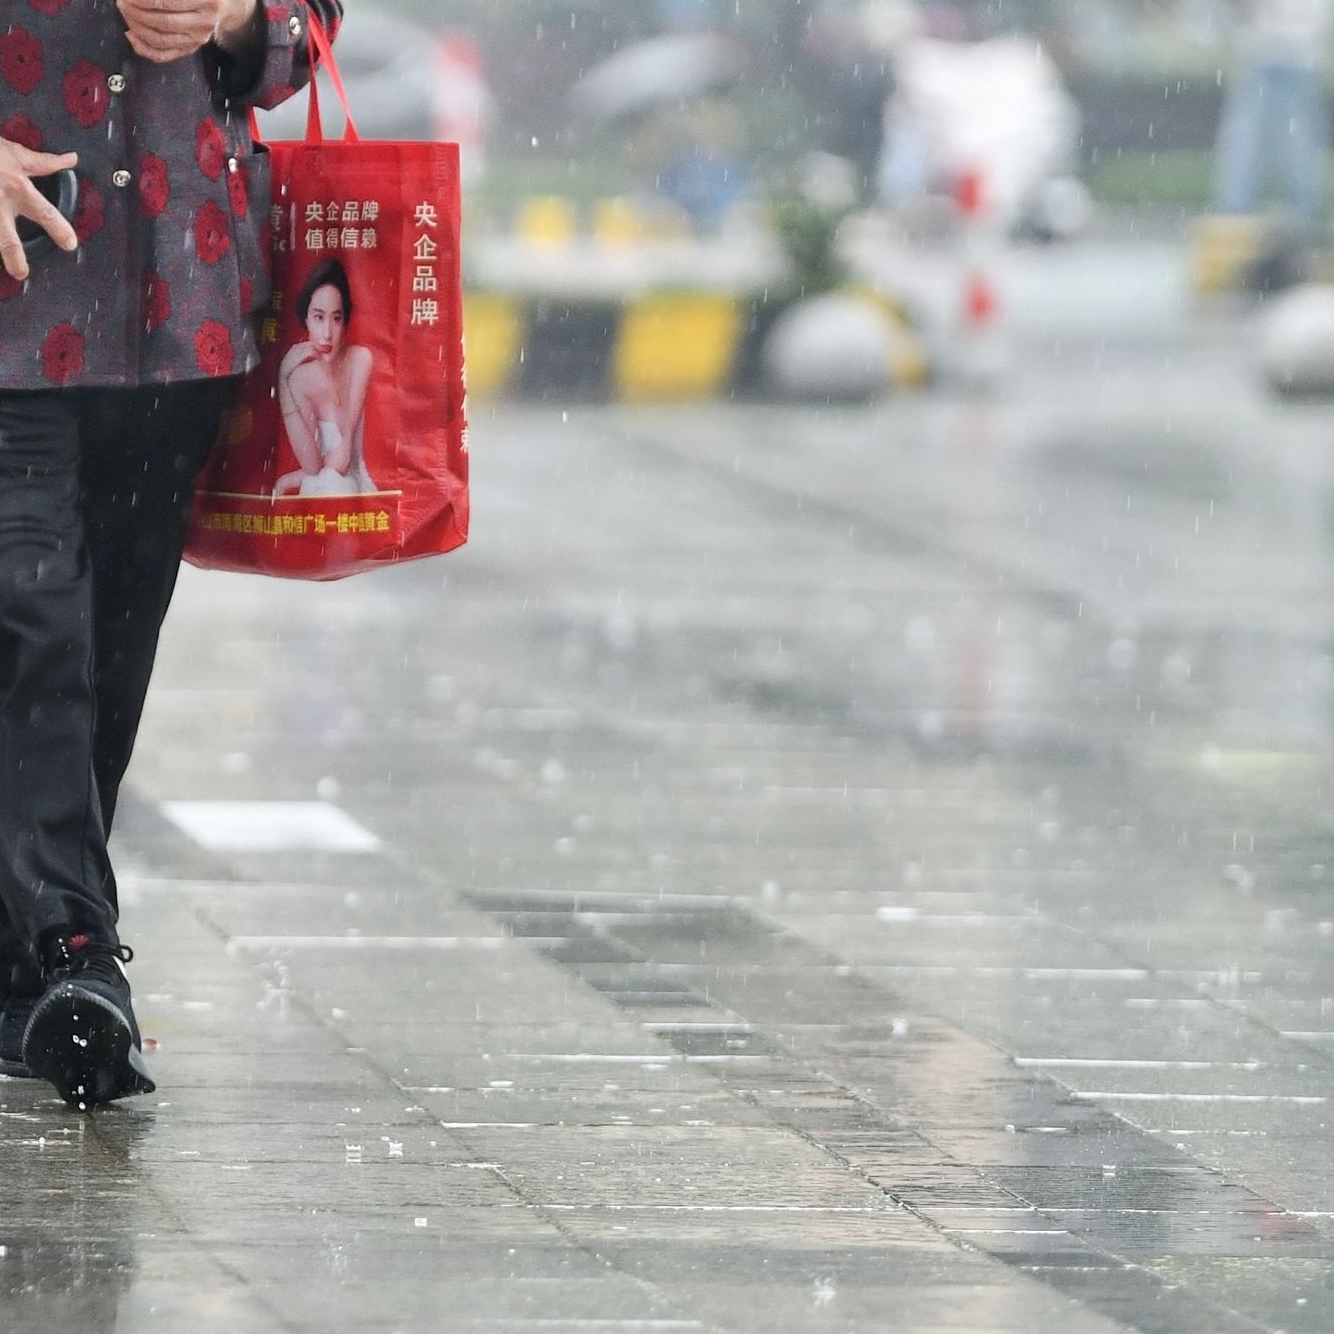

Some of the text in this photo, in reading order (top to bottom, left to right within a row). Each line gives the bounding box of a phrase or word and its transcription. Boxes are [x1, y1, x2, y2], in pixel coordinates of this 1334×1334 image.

[305, 201, 379, 222] 央企品牌
[304, 226, 378, 250] 值得信赖
[411, 200, 439, 326] 央企品牌
